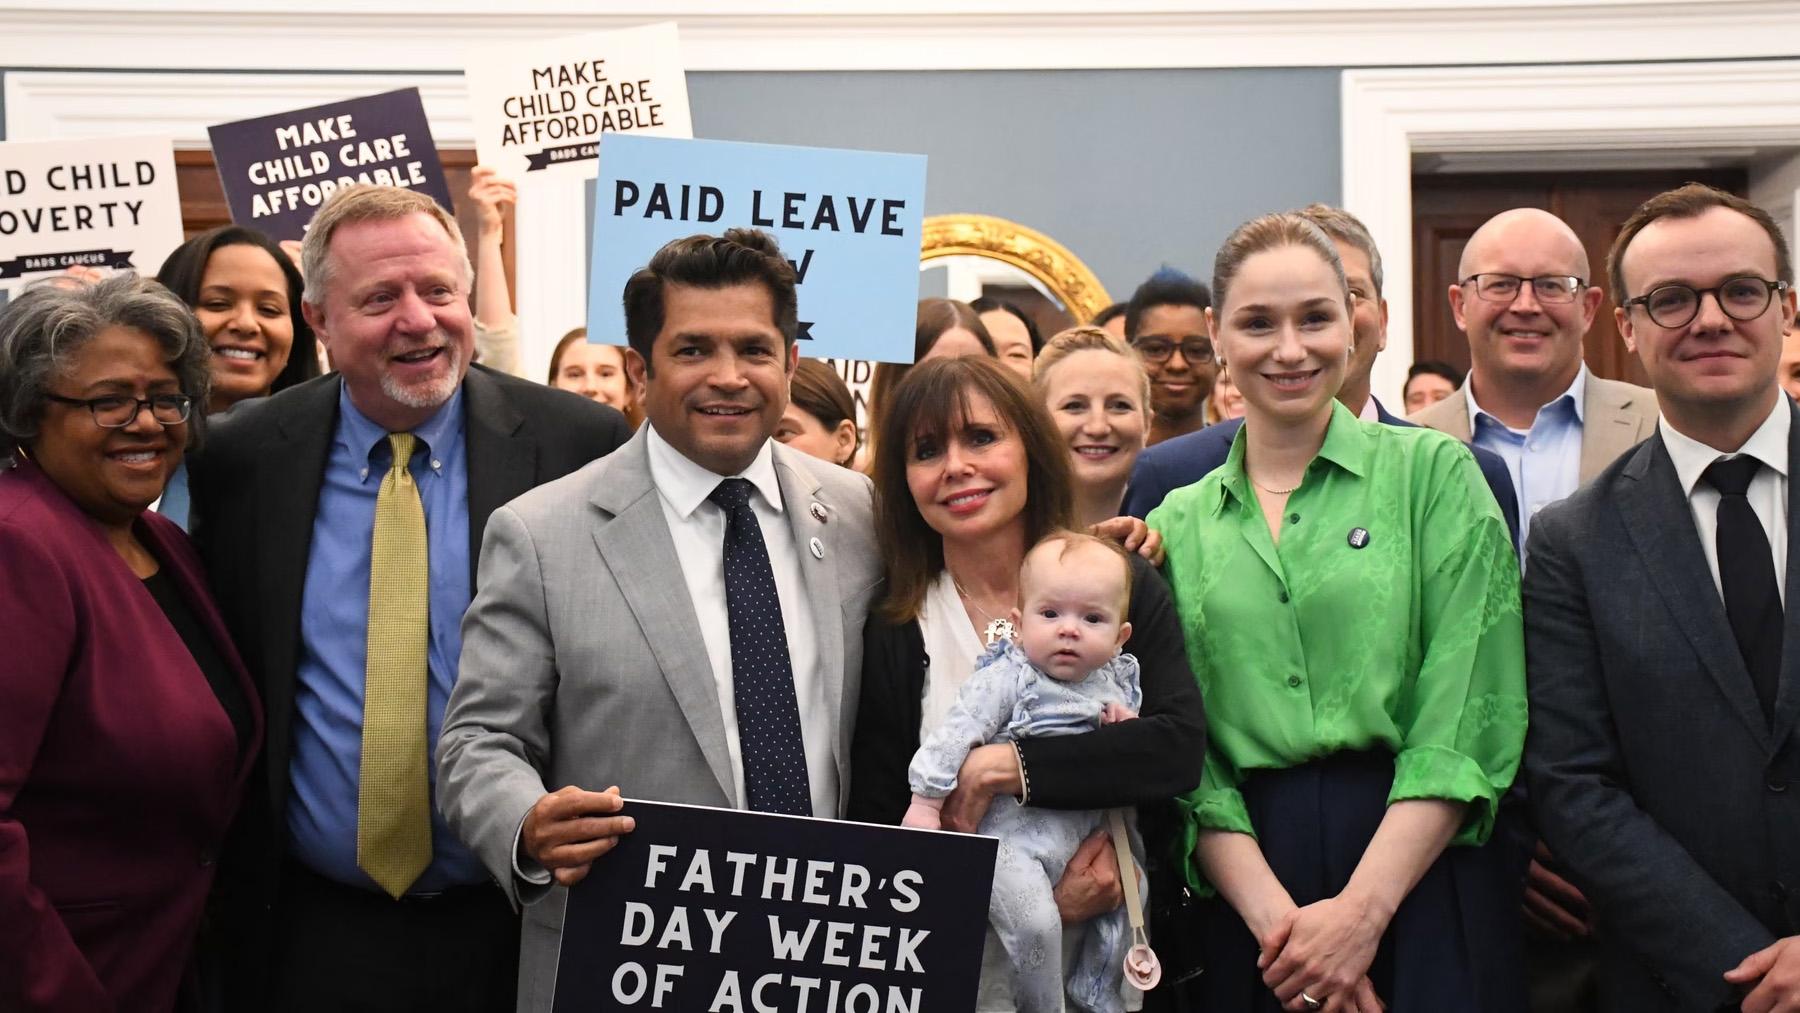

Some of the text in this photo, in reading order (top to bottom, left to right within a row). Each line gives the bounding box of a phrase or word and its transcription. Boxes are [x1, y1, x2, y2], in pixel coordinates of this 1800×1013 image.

[533, 60, 607, 90] MAKE
[503, 80, 653, 119] CHILD CARE
[275, 114, 357, 150] MAKE
[502, 104, 664, 147] AFFORDABLE
[47, 161, 155, 191] CHILD
[248, 134, 411, 185] CHILD CARE
[613, 180, 906, 237] PAID LEAVE
[60, 253, 105, 266] CAUCUS
[644, 844, 925, 913] FATHER'S
[620, 902, 931, 973] DAY WEEK
[611, 961, 923, 1013] OF ACTION
